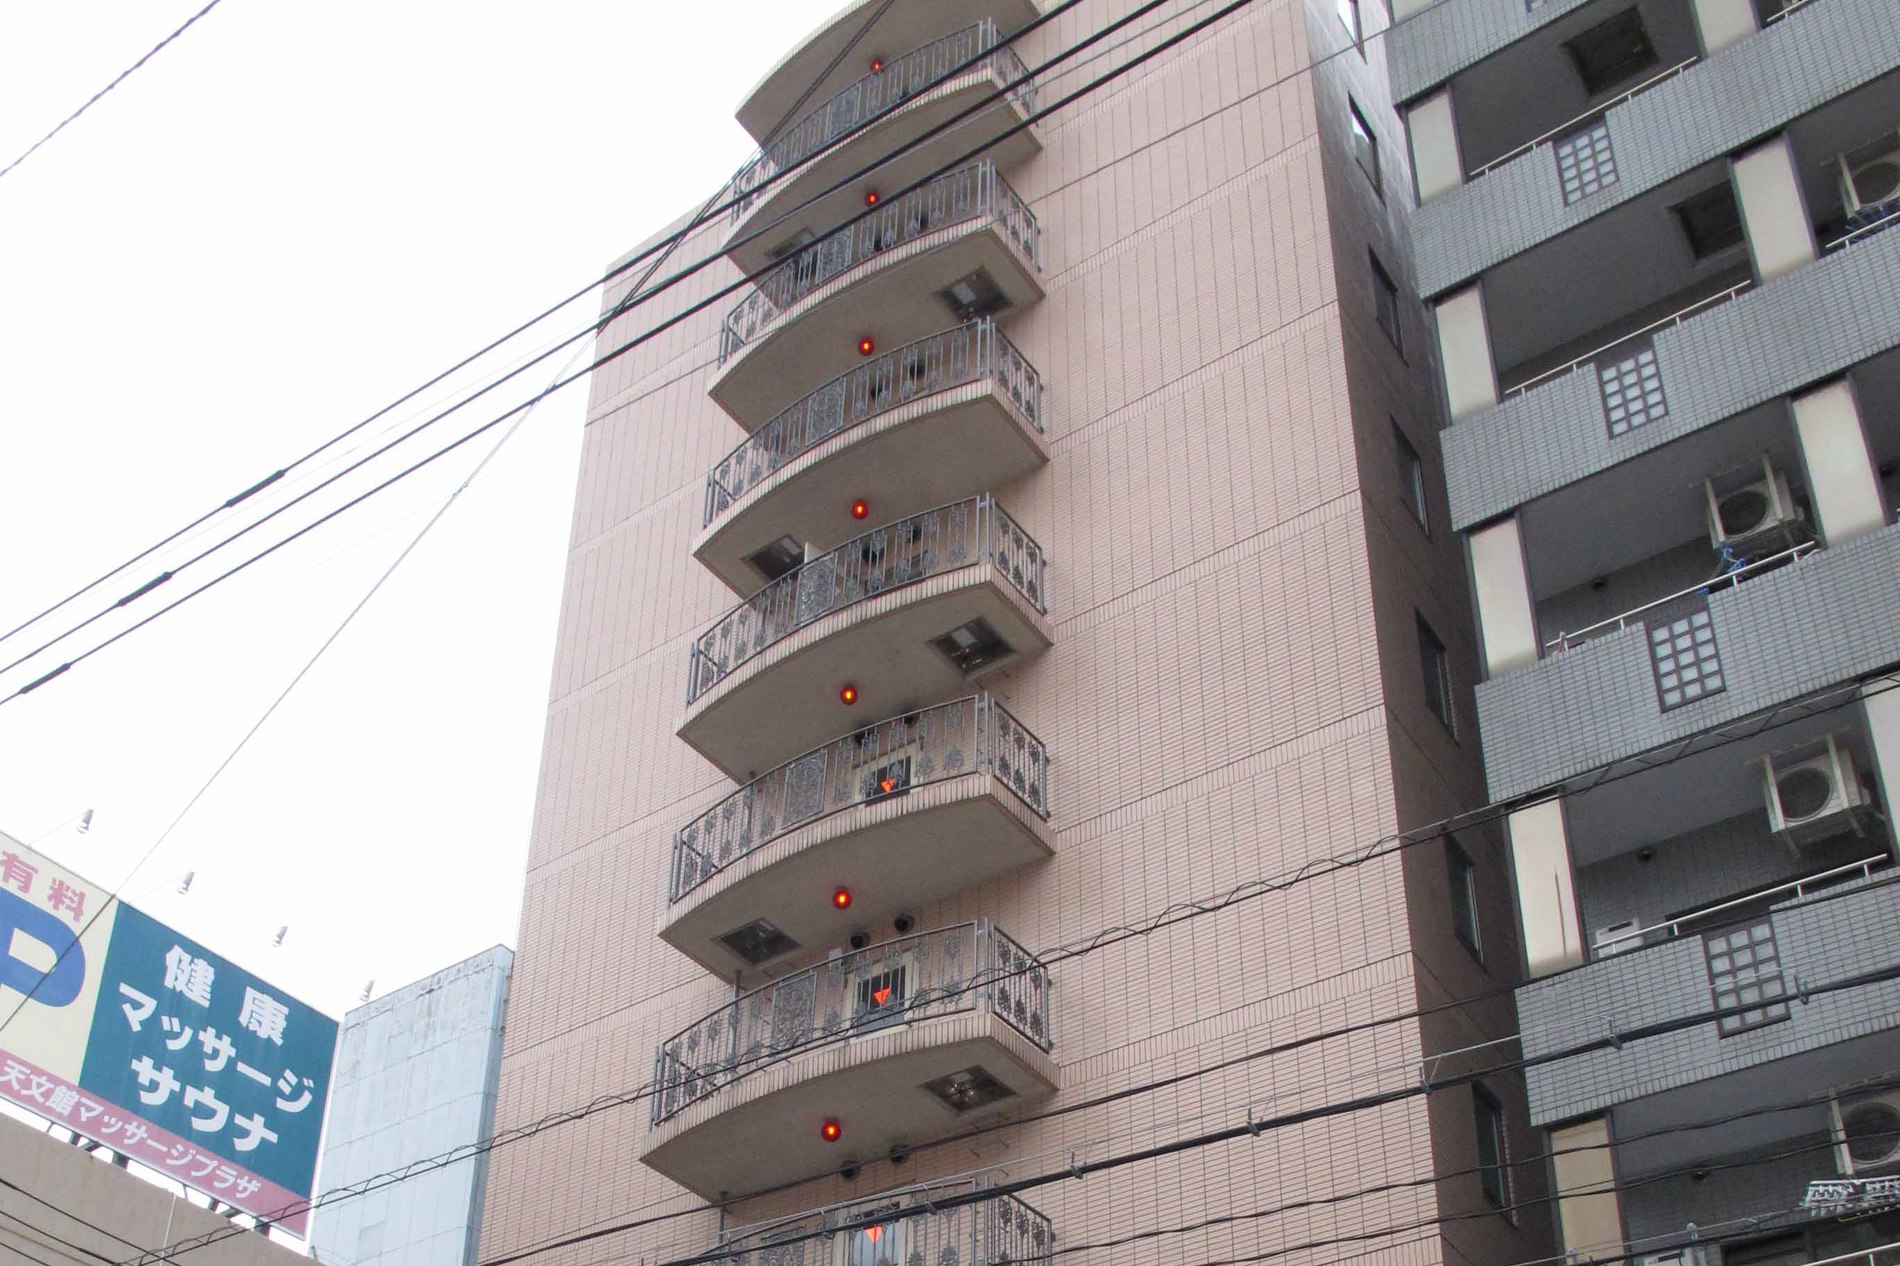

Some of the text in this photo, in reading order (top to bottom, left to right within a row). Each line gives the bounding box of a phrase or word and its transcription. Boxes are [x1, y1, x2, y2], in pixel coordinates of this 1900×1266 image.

[0, 850, 86, 922] 有料
[118, 981, 314, 1113] マッサージ
[164, 944, 289, 1047] 健康
[0, 1059, 261, 1199] 天文館マッサージプラザ
[130, 1055, 279, 1152] サウナ
